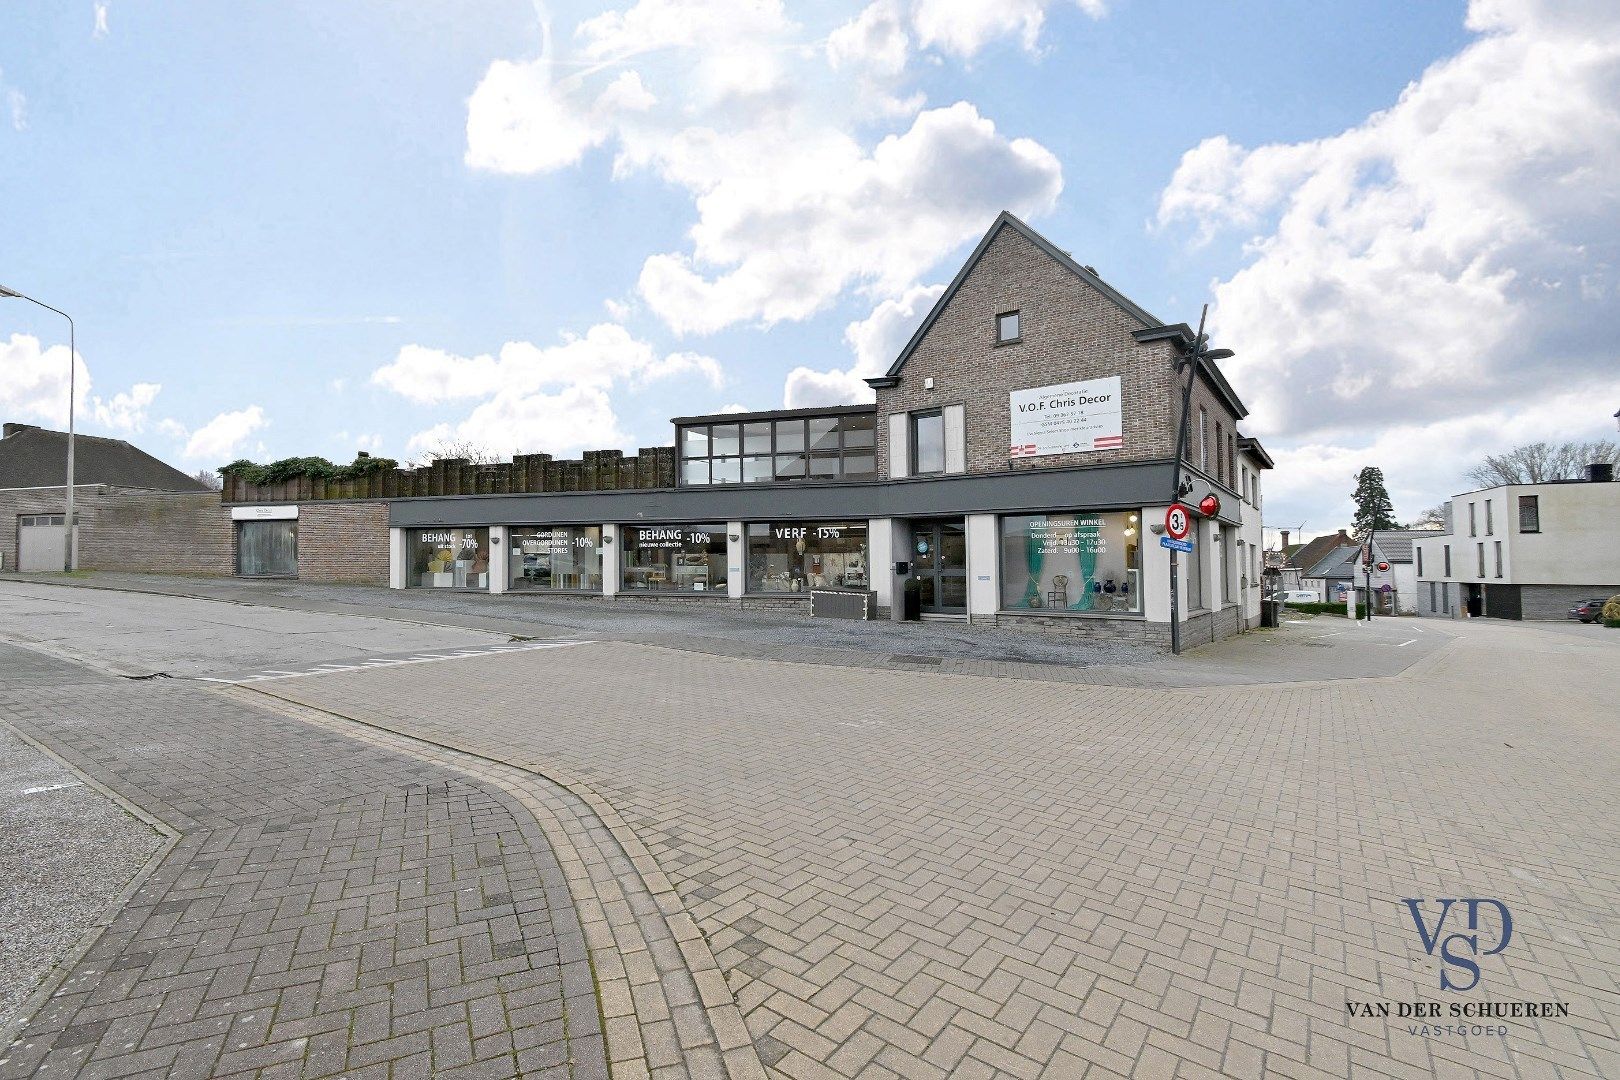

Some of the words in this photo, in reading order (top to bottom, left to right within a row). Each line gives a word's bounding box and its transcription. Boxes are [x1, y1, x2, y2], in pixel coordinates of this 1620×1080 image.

[1019, 401, 1046, 413] V.O.F.
[1050, 398, 1076, 408] Chris
[1080, 394, 1111, 405] Decor
[422, 533, 456, 542] BEHANG
[640, 530, 682, 540] BEHANG
[686, 532, 710, 544] -10%
[776, 528, 806, 538] VERF
[812, 528, 840, 538] -15%
[1074, 531, 1100, 539] afspraak
[459, 538, 478, 548] -70%
[572, 537, 593, 548] -10%
